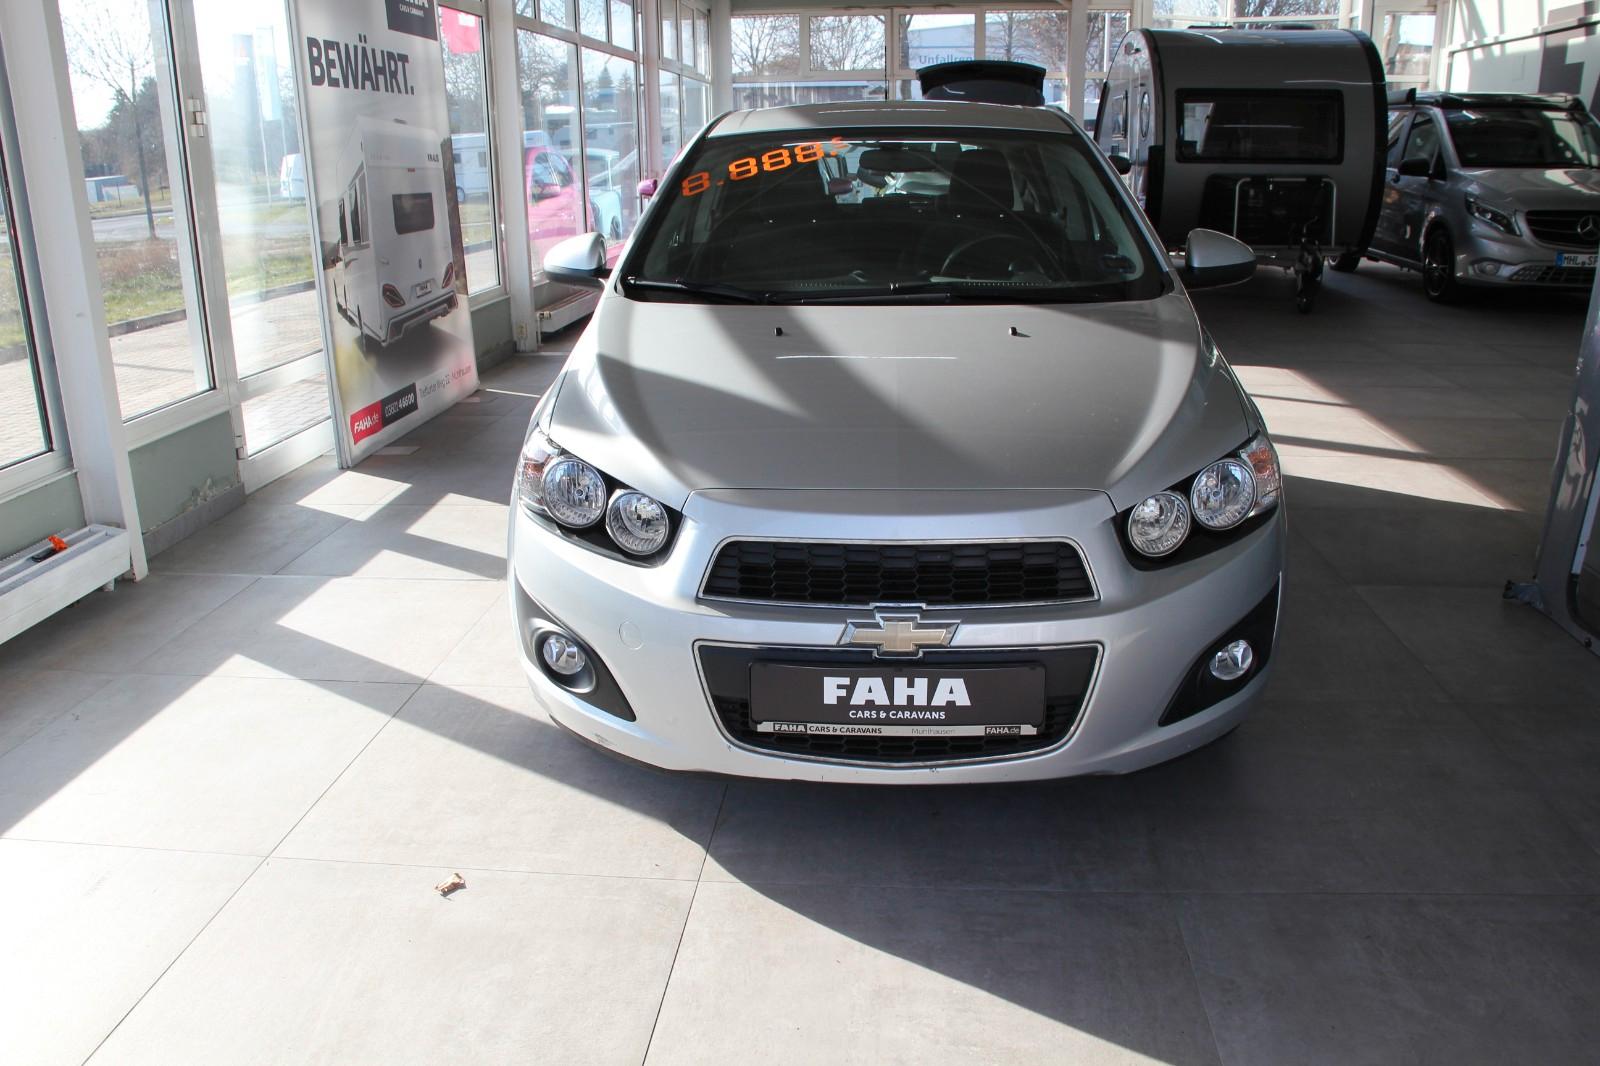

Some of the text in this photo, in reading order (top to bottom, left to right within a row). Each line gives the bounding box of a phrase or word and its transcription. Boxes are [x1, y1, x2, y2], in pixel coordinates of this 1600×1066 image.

[306, 33, 415, 96] BEWÄHRT.
[823, 676, 971, 706] FAHA
[849, 710, 946, 720] CARS & CARAVANS
[774, 723, 806, 732] FAHA
[808, 725, 831, 733] CARS
[839, 726, 883, 735] CARAVANS
[986, 726, 1020, 735] FAHA.de
